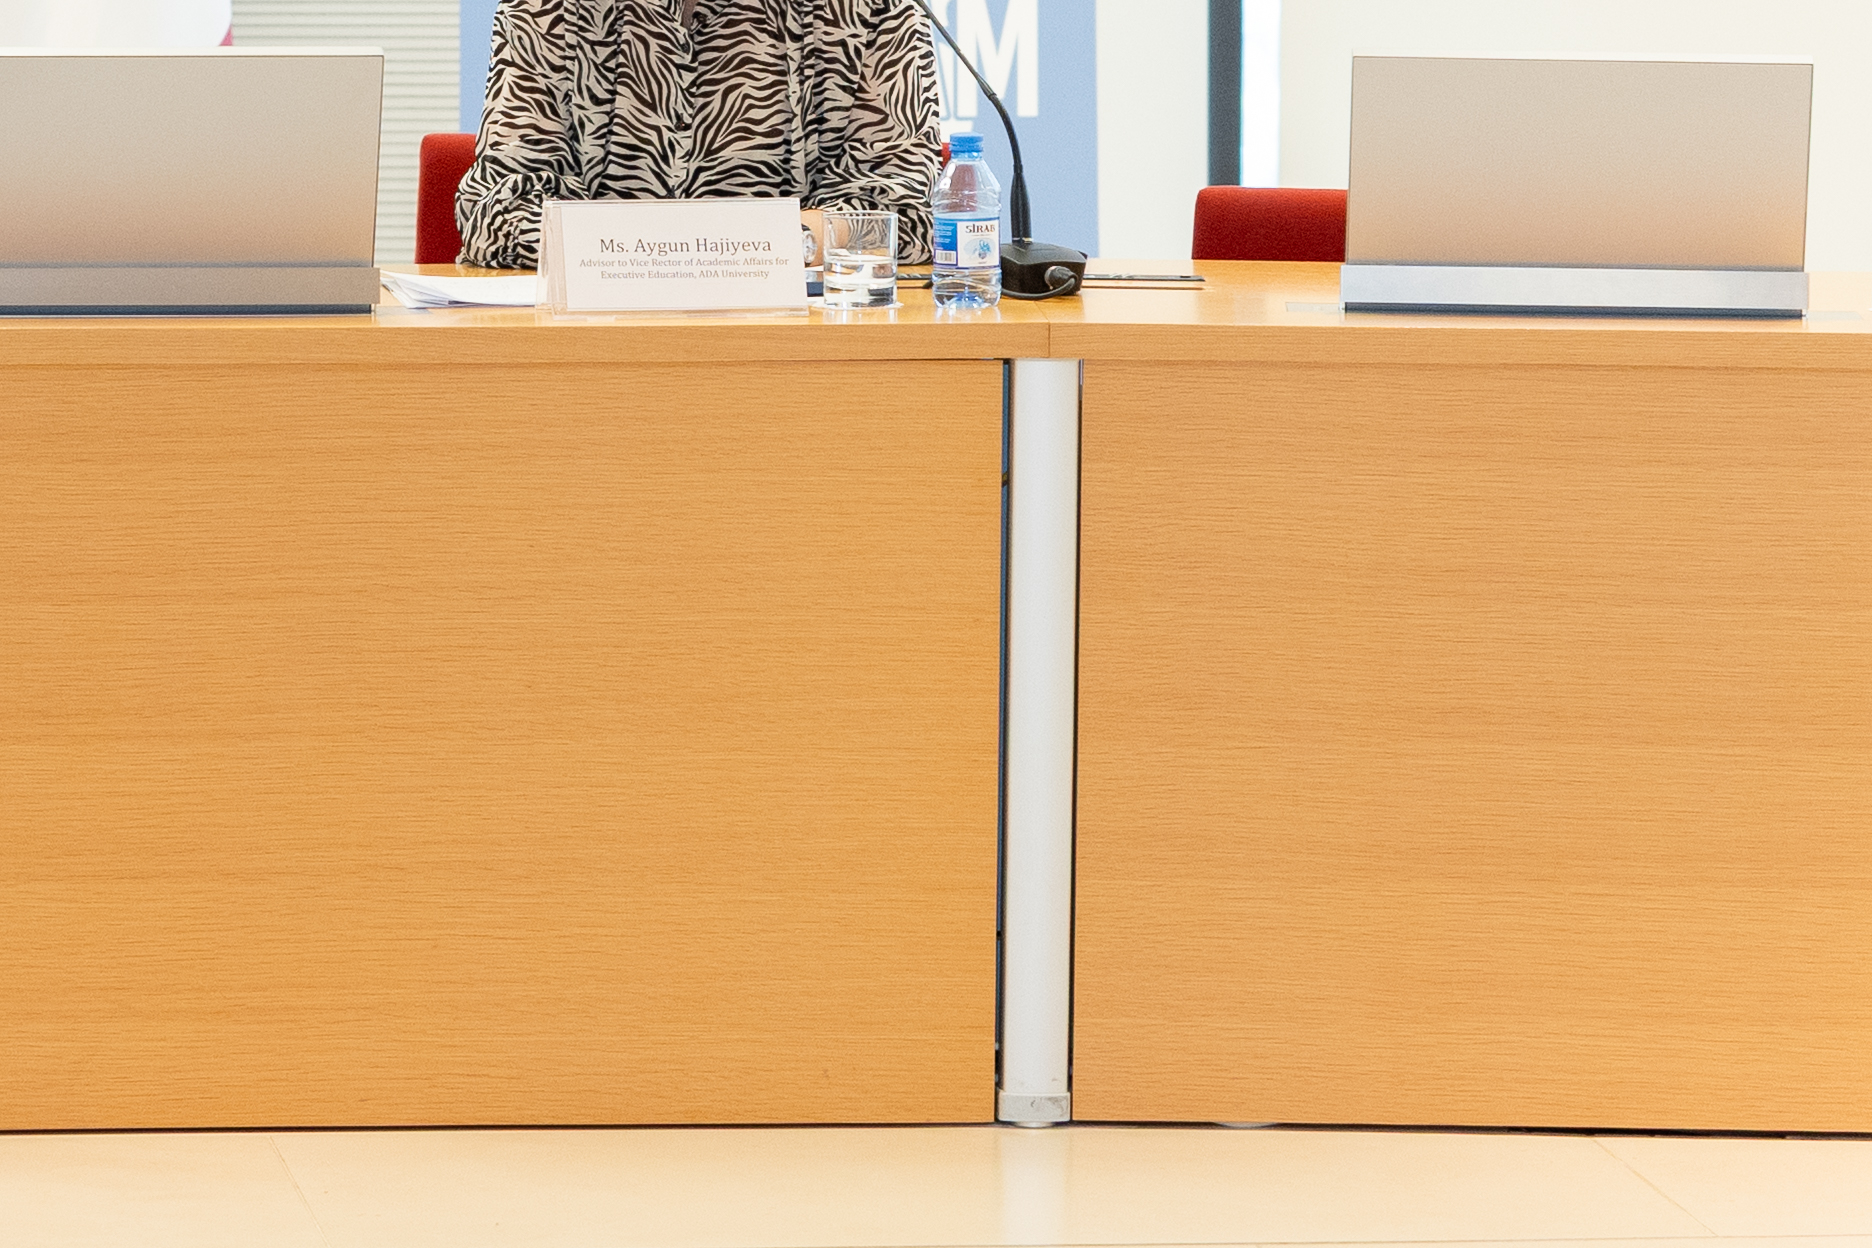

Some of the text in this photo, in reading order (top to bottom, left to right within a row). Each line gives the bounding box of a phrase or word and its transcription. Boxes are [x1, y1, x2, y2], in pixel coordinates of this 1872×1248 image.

[599, 237, 772, 256] Ms. Aygun Hajiyeva
[579, 256, 790, 268] Advisor to Vice Rector of Academic Affairs for
[600, 268, 770, 281] Executive Education, ADA University
